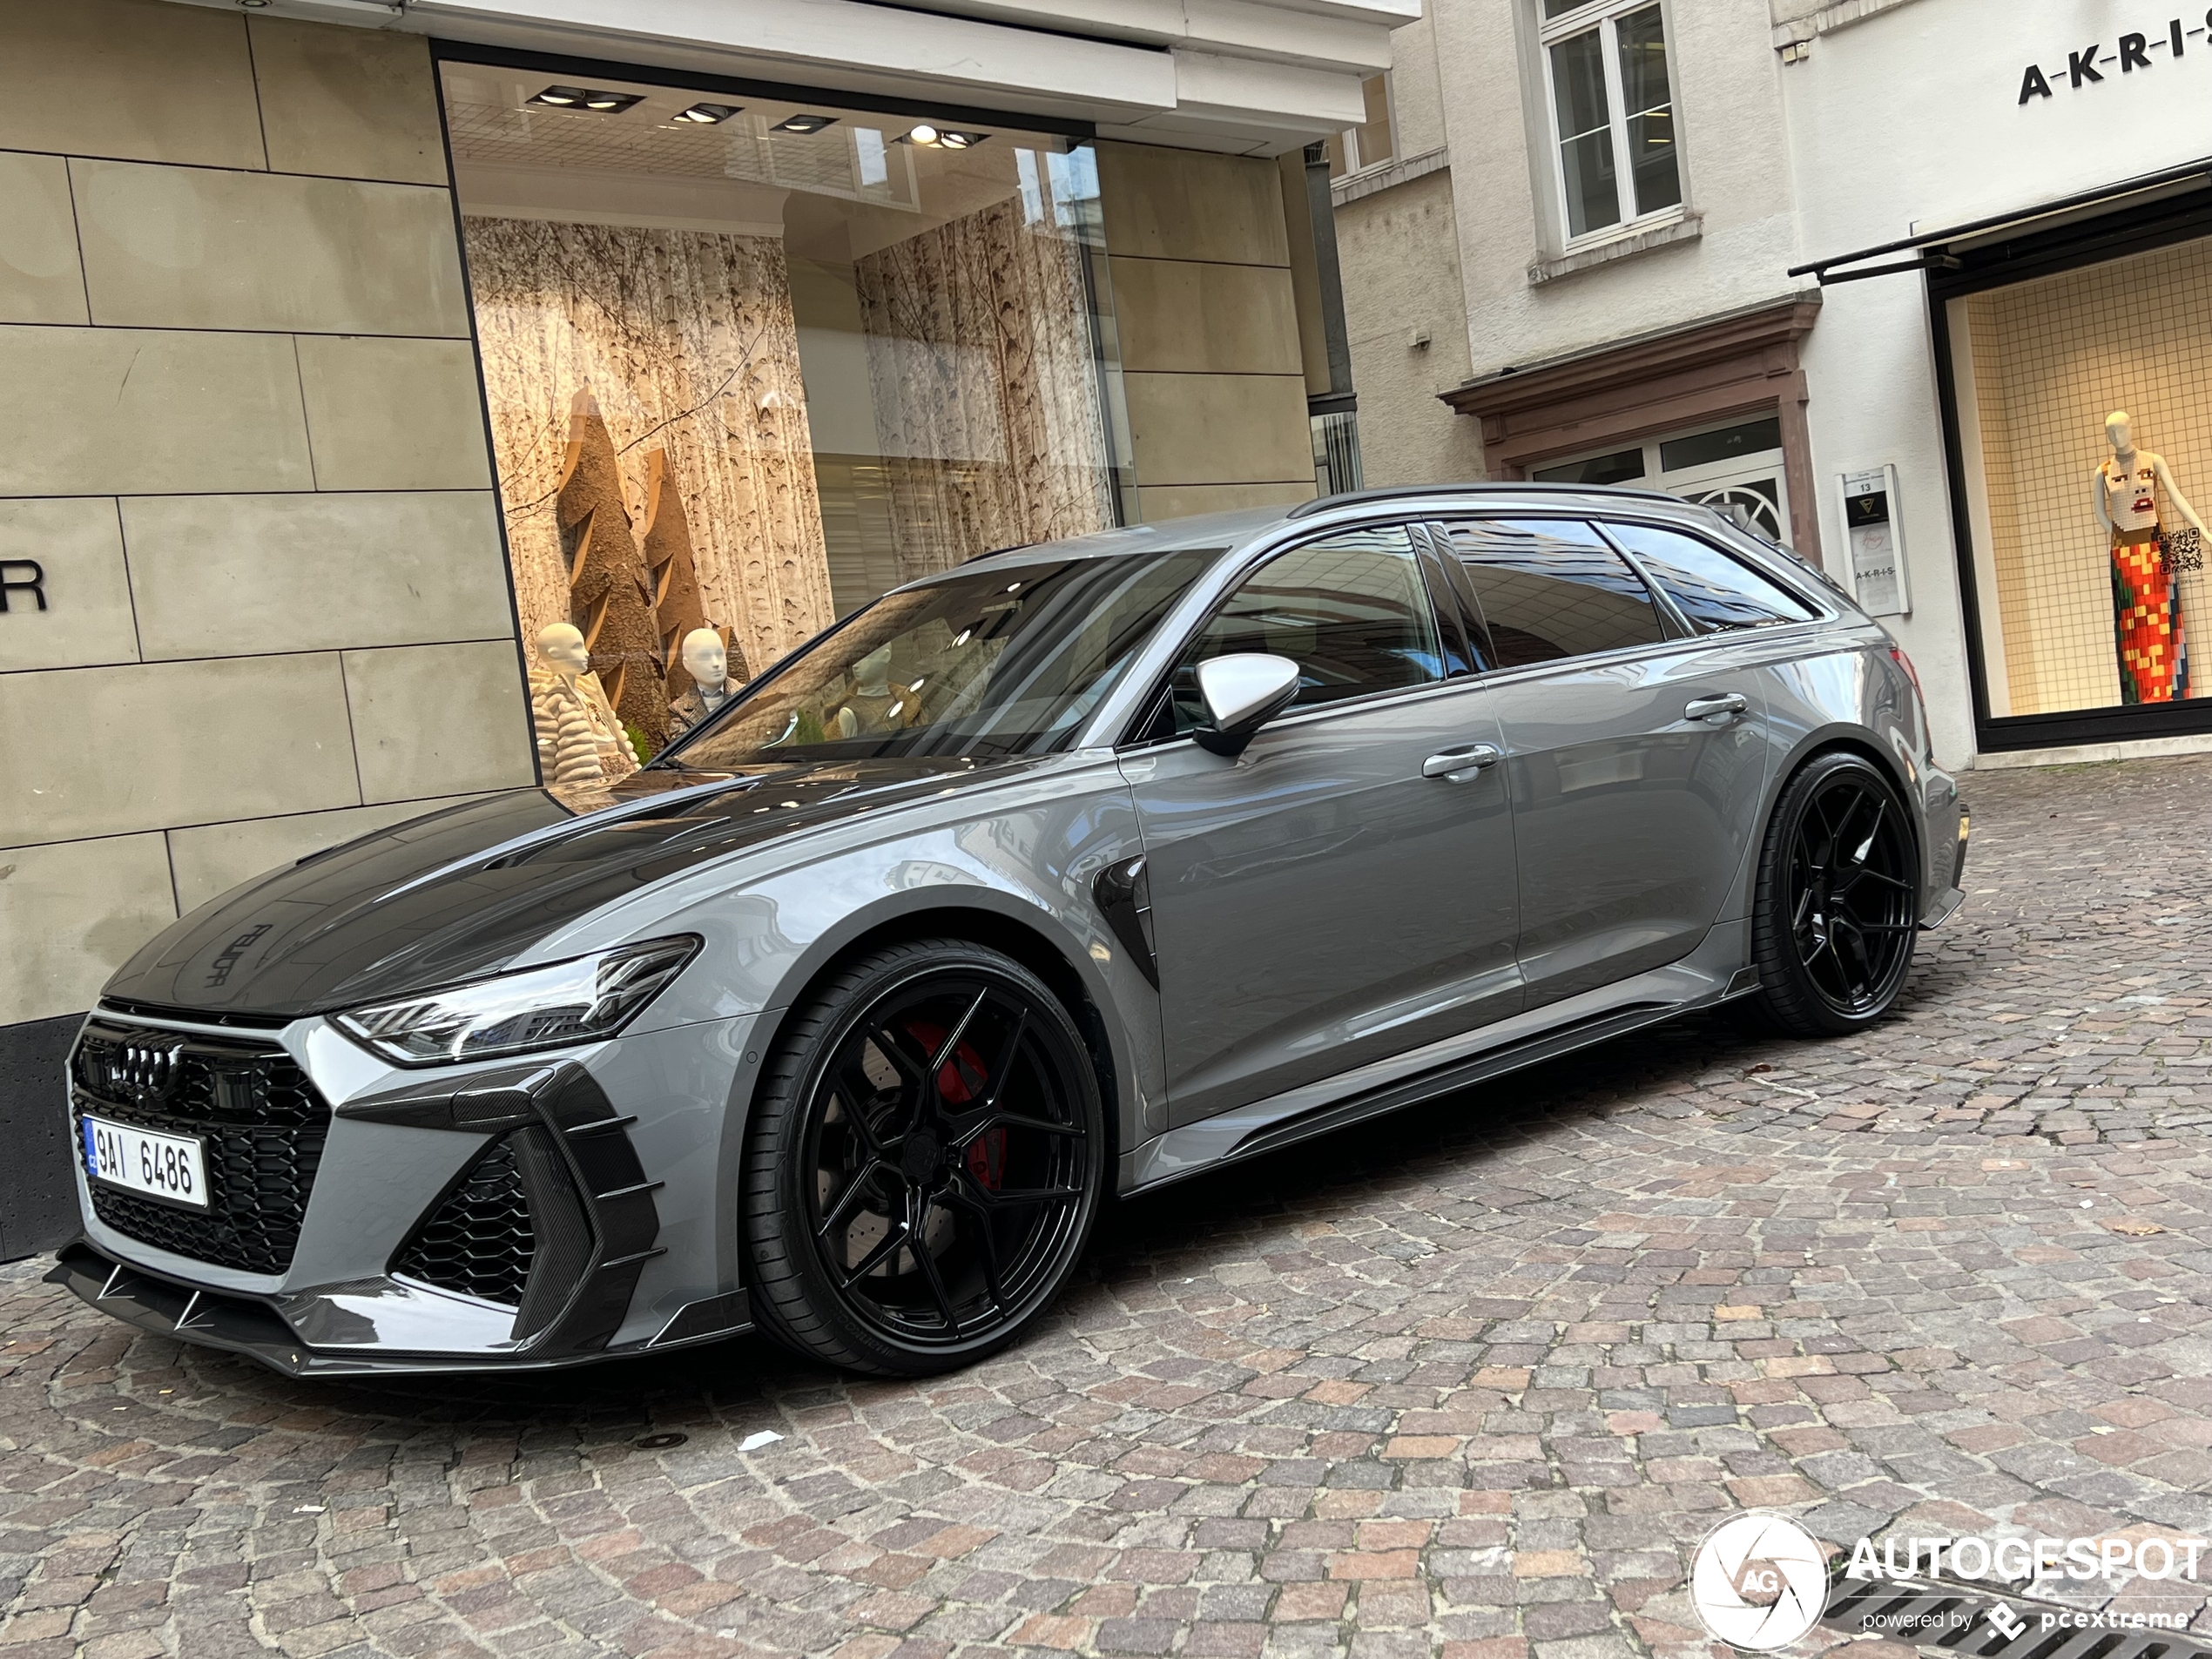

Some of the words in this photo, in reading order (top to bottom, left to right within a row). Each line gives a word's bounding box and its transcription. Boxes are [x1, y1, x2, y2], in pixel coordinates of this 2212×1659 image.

[2018, 7, 2212, 105] A-K-R-I-
[1860, 483, 1871, 492] 13
[140, 1139, 192, 1195] 6486
